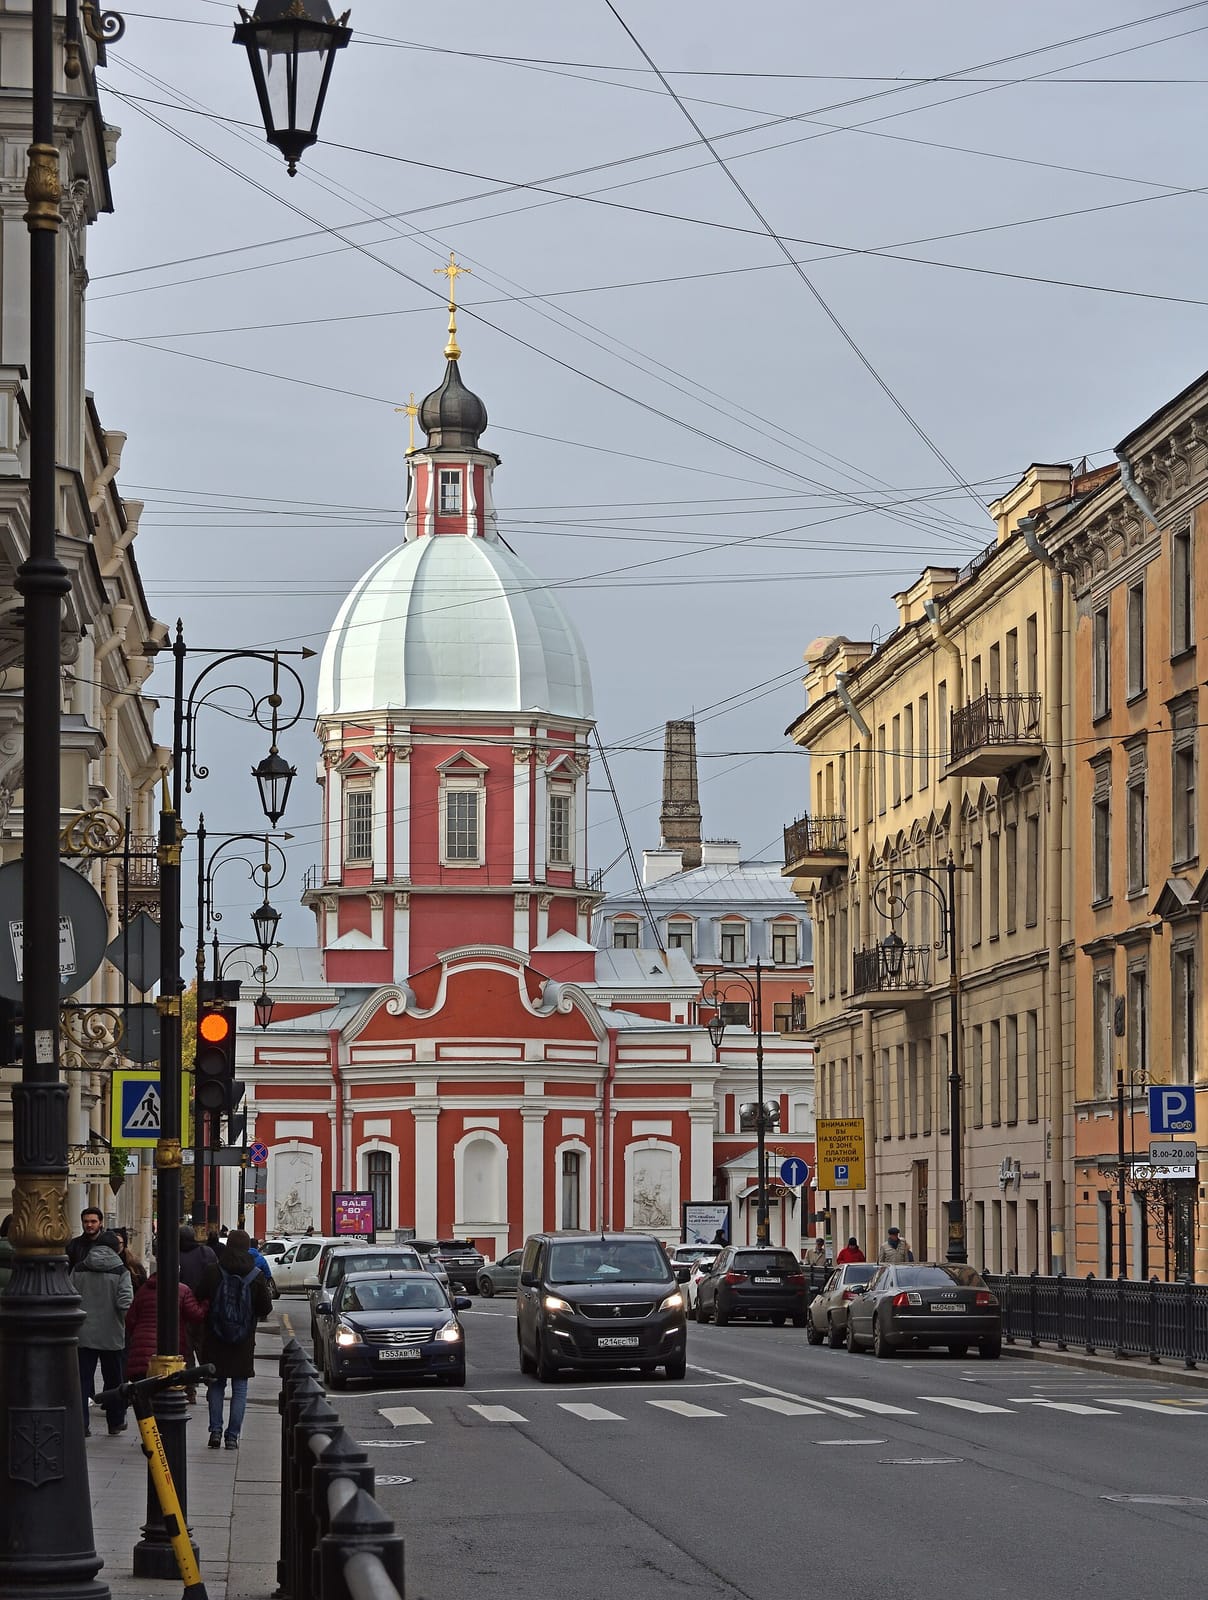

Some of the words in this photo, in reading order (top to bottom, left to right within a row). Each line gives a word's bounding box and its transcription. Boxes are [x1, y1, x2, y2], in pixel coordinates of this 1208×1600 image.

[1162, 1092, 1187, 1129] P
[1152, 1150, 1194, 1158] 8.00-20.00
[73, 1157, 105, 1166] ATRIKA
